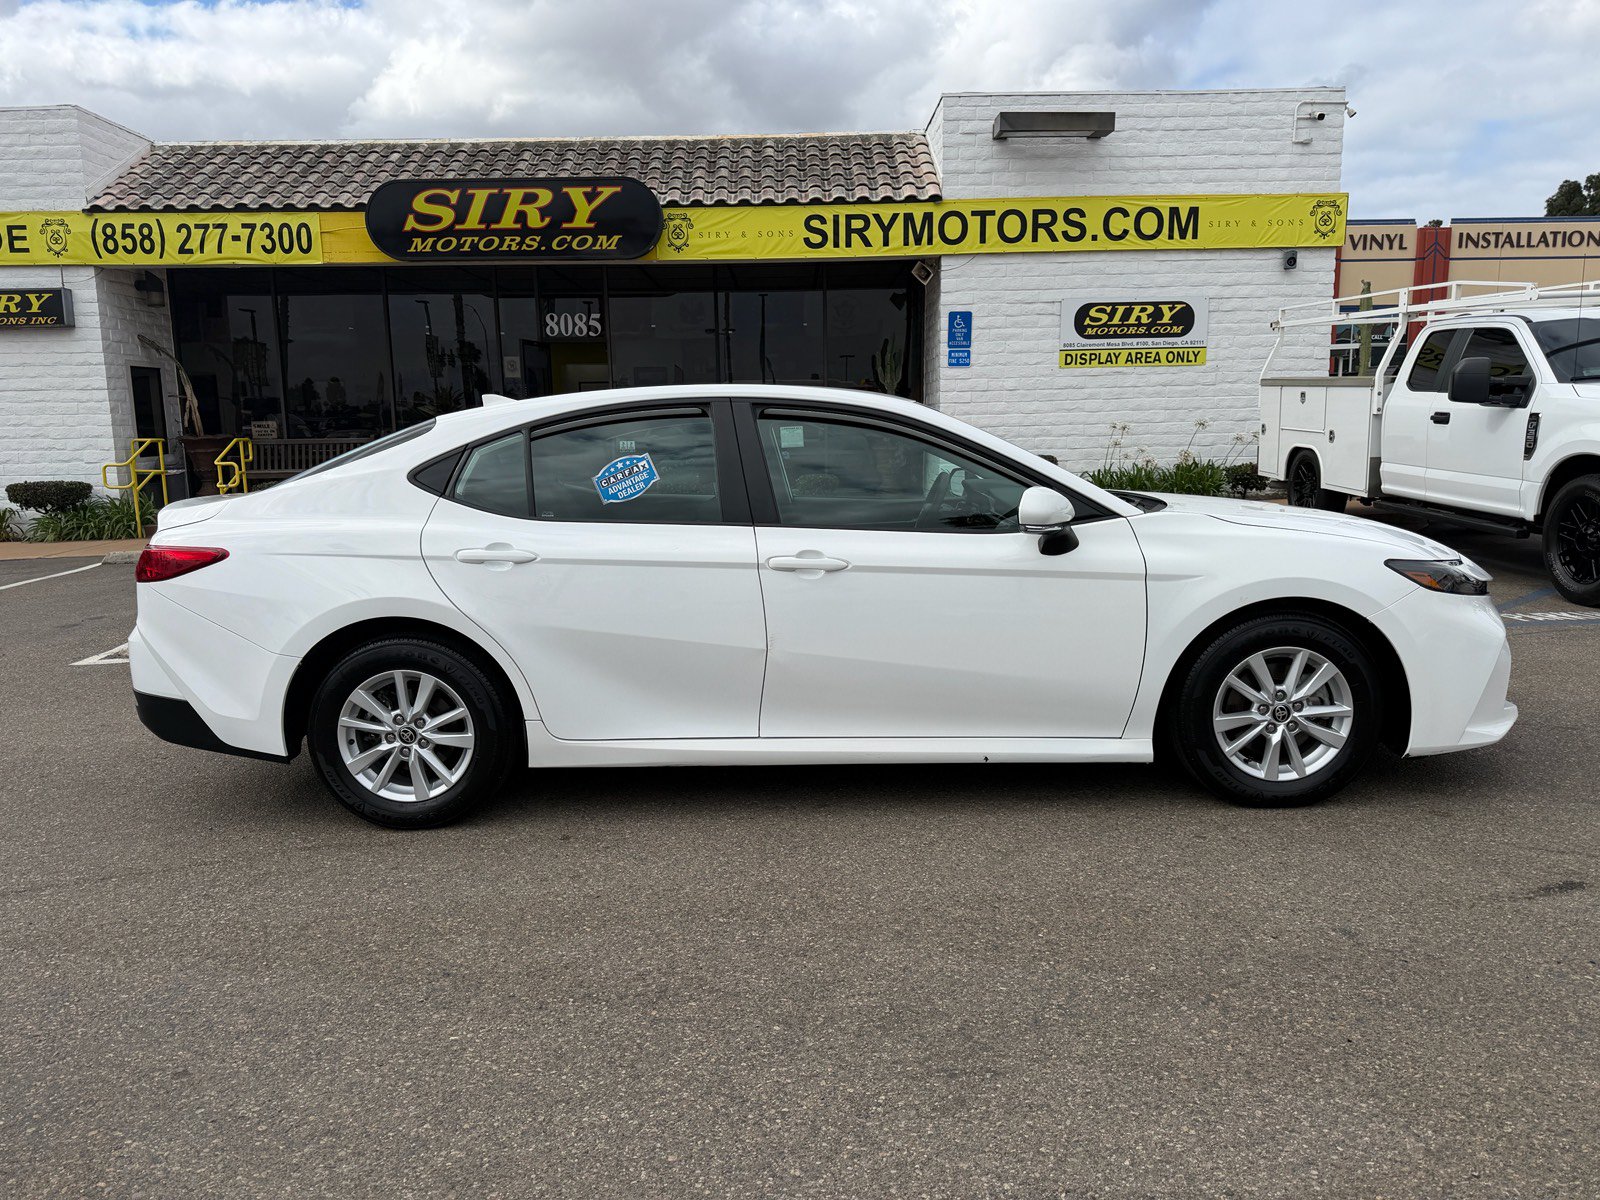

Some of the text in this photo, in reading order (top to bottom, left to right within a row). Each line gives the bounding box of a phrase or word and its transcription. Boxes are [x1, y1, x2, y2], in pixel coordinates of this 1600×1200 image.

[402, 186, 623, 232] SIRY
[803, 206, 1199, 248] SIRYMOTORS.COM
[1208, 219, 1304, 228] SIRY & SONS
[0, 218, 312, 259] E (858) 277-7300
[407, 234, 622, 253] MOTORS.COM
[699, 230, 794, 239] SIRY & SONS
[1348, 233, 1408, 251] VINYL
[1458, 230, 1600, 249] INSTALLATION
[29, 316, 57, 325] INC
[1084, 304, 1187, 325] SIRY
[544, 312, 602, 337] 8085
[1084, 325, 1185, 336] MOTORS.COM
[1064, 350, 1201, 366] DISPLAY AREA ONLY
[600, 461, 648, 487] CARFAX
[608, 471, 650, 495] ADVANTAGE
[617, 481, 646, 499] DEALER
